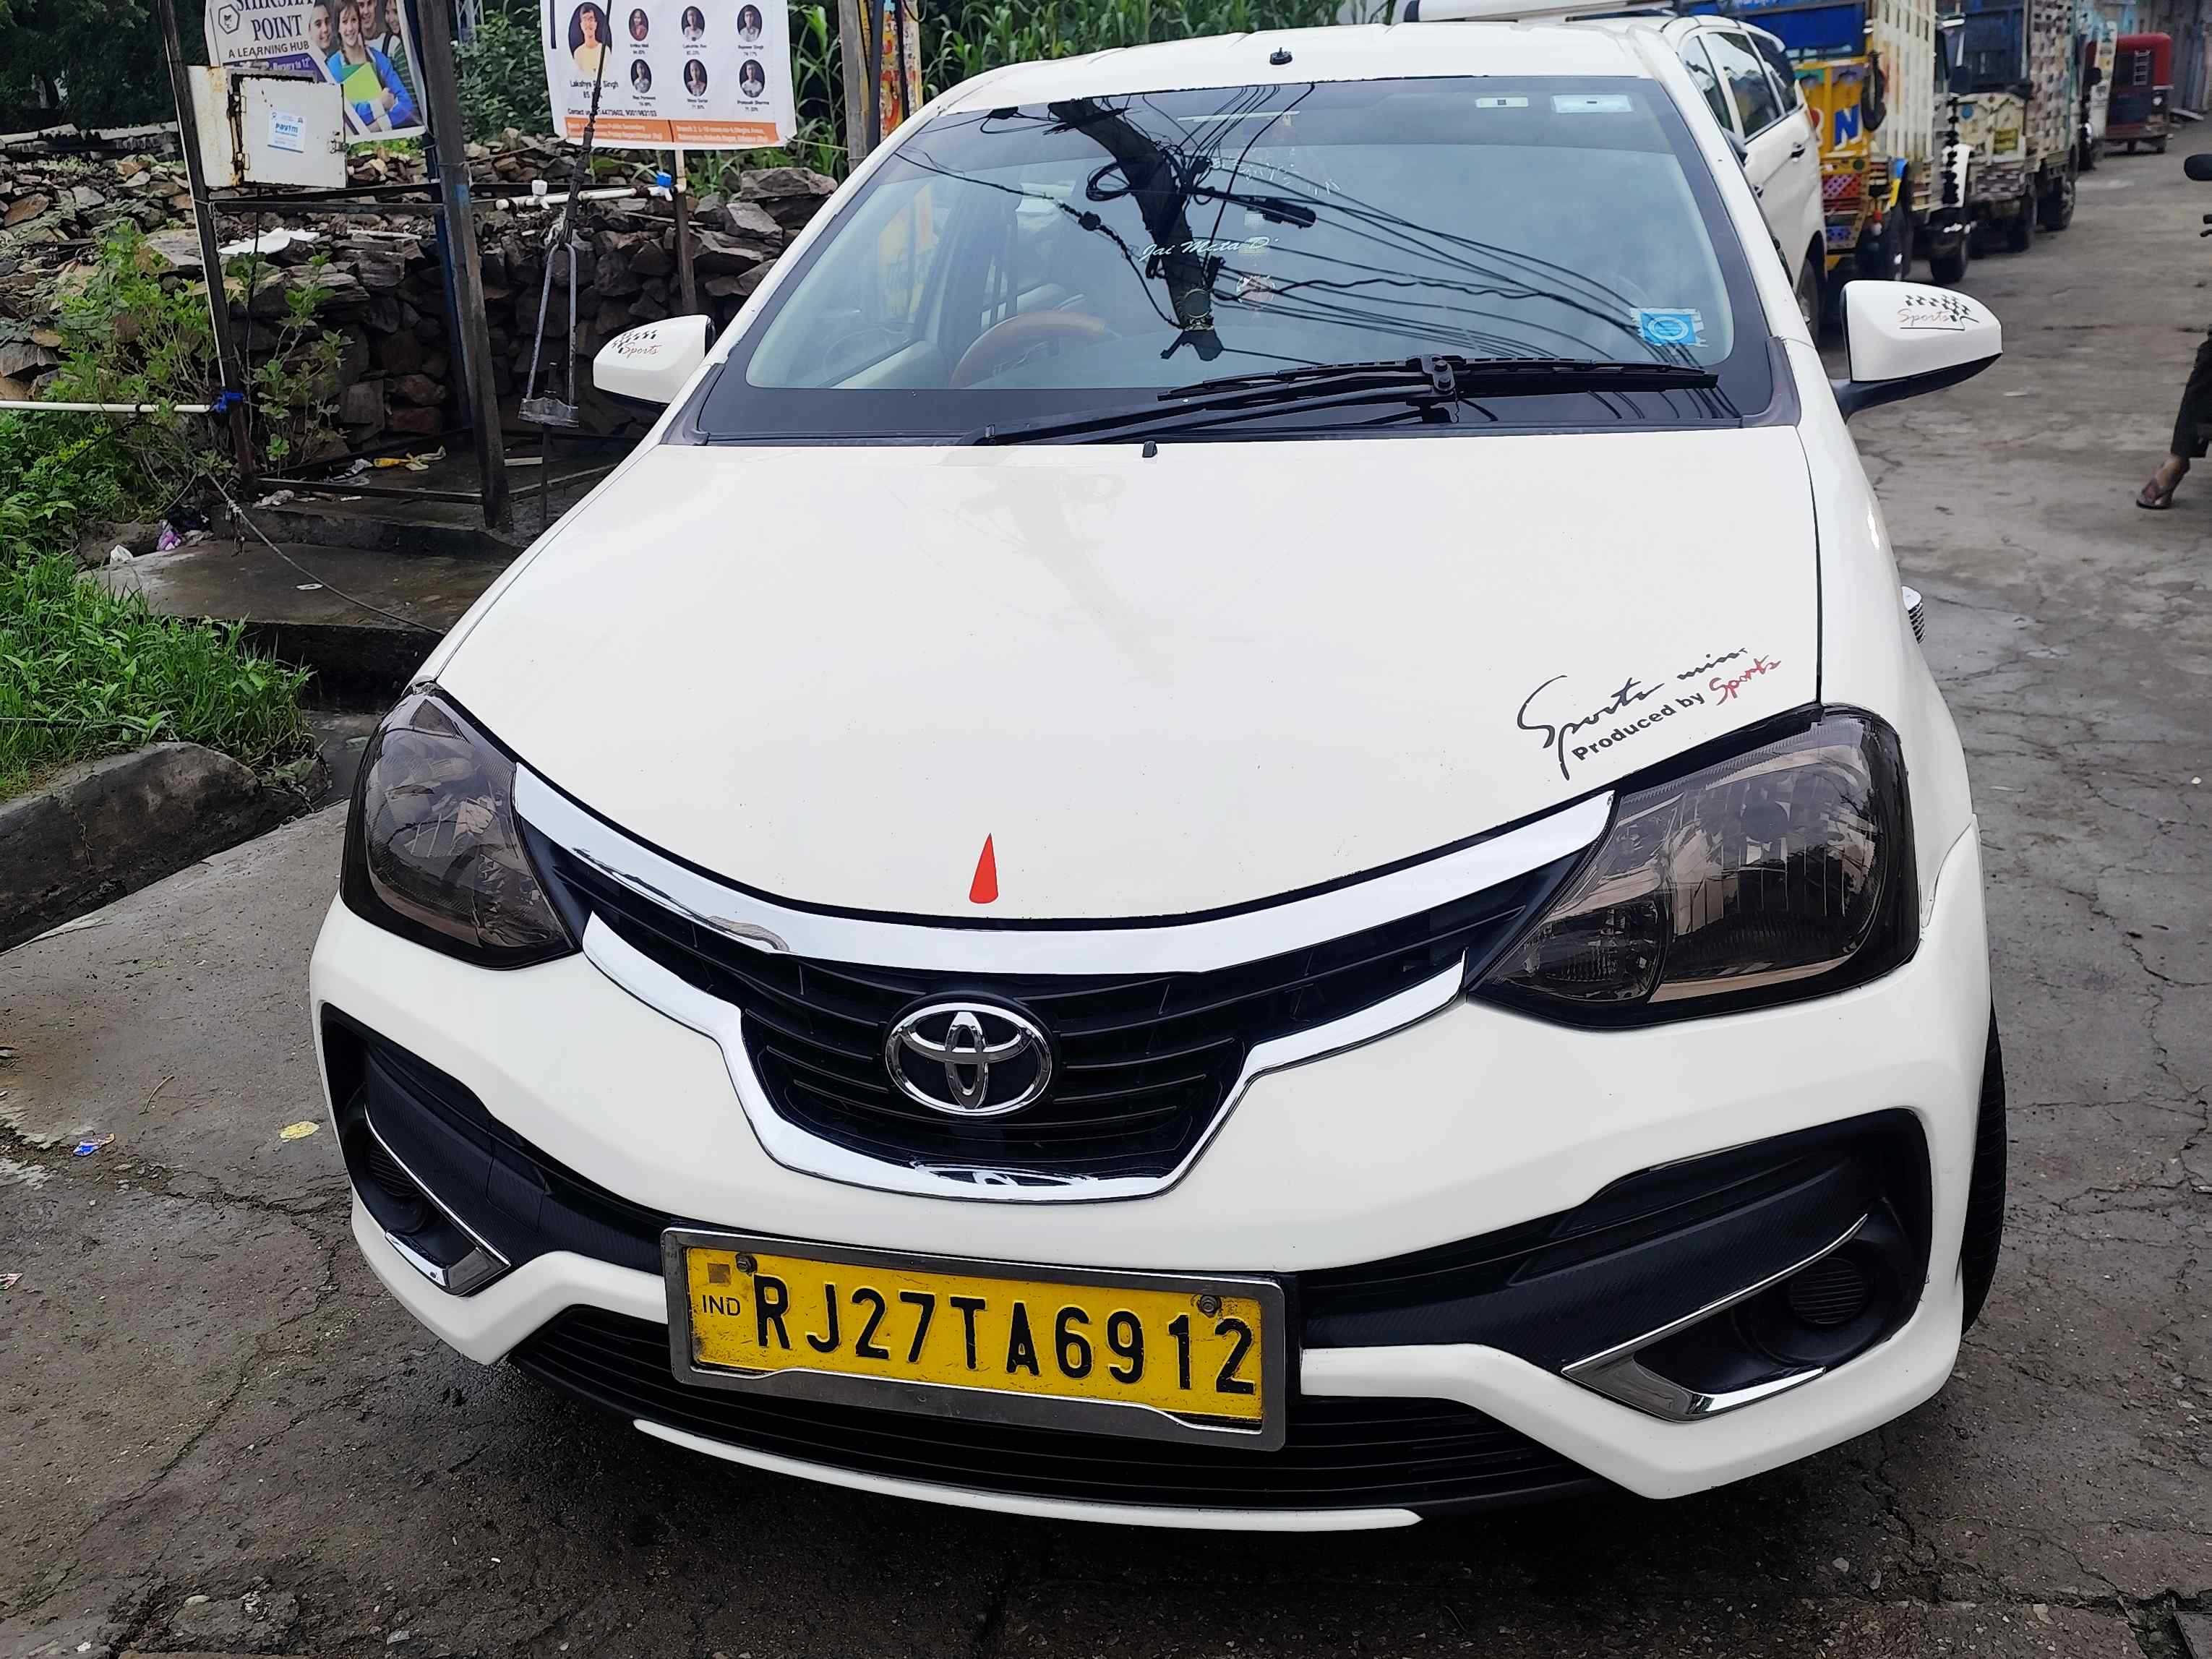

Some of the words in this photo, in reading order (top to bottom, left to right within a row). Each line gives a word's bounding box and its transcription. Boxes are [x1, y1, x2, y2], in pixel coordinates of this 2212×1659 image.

[251, 14, 301, 41] POINT
[228, 49, 236, 59] A
[237, 43, 288, 57] LEARNING
[290, 40, 309, 51] HUB
[1139, 244, 1175, 262] Jai
[1897, 308, 1950, 327] Sports
[623, 342, 663, 359] Sports
[1572, 703, 1678, 761] Produced
[1674, 692, 1705, 708] by
[1708, 654, 1782, 706] Sports
[1517, 674, 1665, 781] Sports
[701, 1294, 742, 1318] IND
[753, 1272, 1256, 1397] RJ27TA6912
